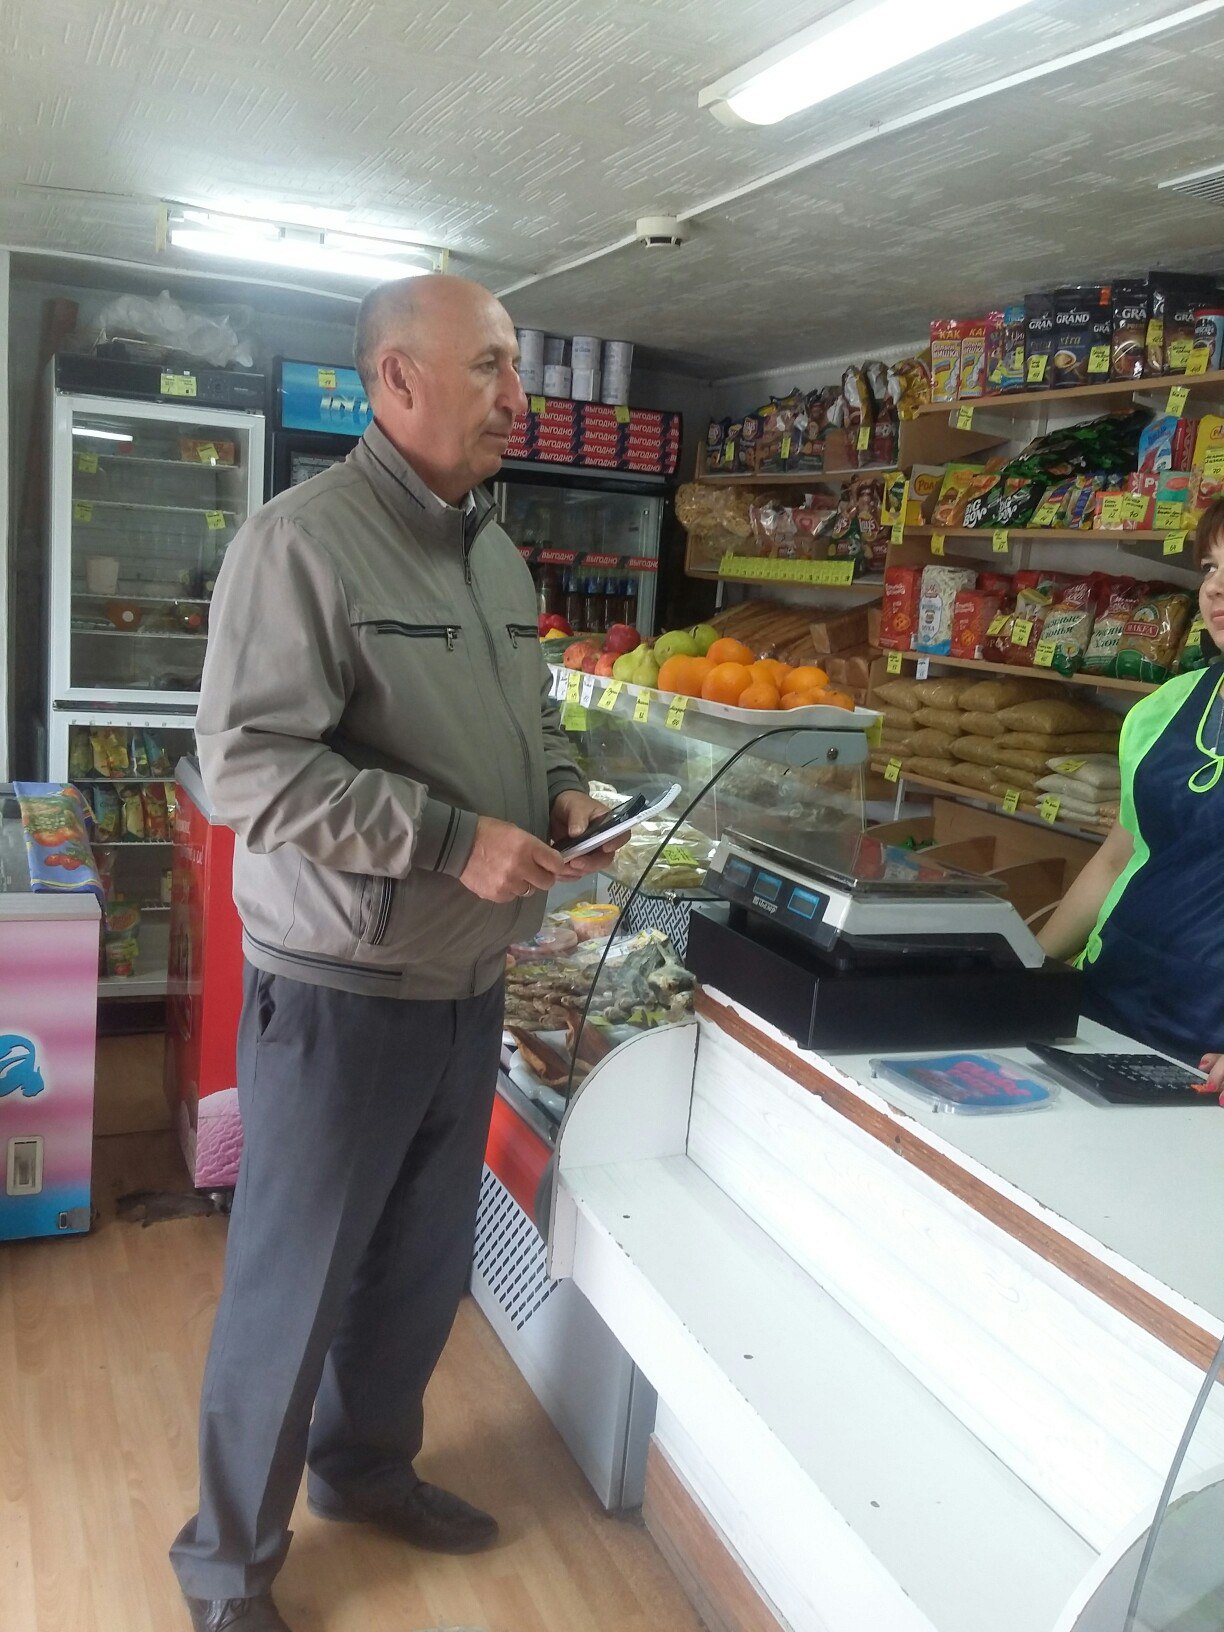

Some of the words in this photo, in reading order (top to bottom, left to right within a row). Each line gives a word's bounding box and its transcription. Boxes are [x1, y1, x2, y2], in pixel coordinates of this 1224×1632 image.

[1056, 313, 1090, 324] GRAND
[1122, 308, 1146, 320] GRA
[1029, 318, 1053, 330] GRAN
[585, 418, 618, 429] ВЫГОДНО
[629, 424, 662, 434] ВЫГОДНО
[539, 425, 574, 436] ВЫГОДНО
[584, 431, 618, 442] ВЫГОДНО
[629, 437, 662, 448] ВЫГОДНО
[537, 438, 572, 449] ВЫГОДНО
[583, 444, 617, 455] ВЫГОДНО
[627, 449, 660, 460] ВЫГОДНО
[539, 452, 574, 463] ВЫГОДНО
[584, 457, 618, 468] ВЫГОДНО
[628, 463, 661, 473] ВЫГОДНО
[541, 551, 575, 561] ВЫГОДНО
[585, 555, 618, 565] ВЫГОДНО
